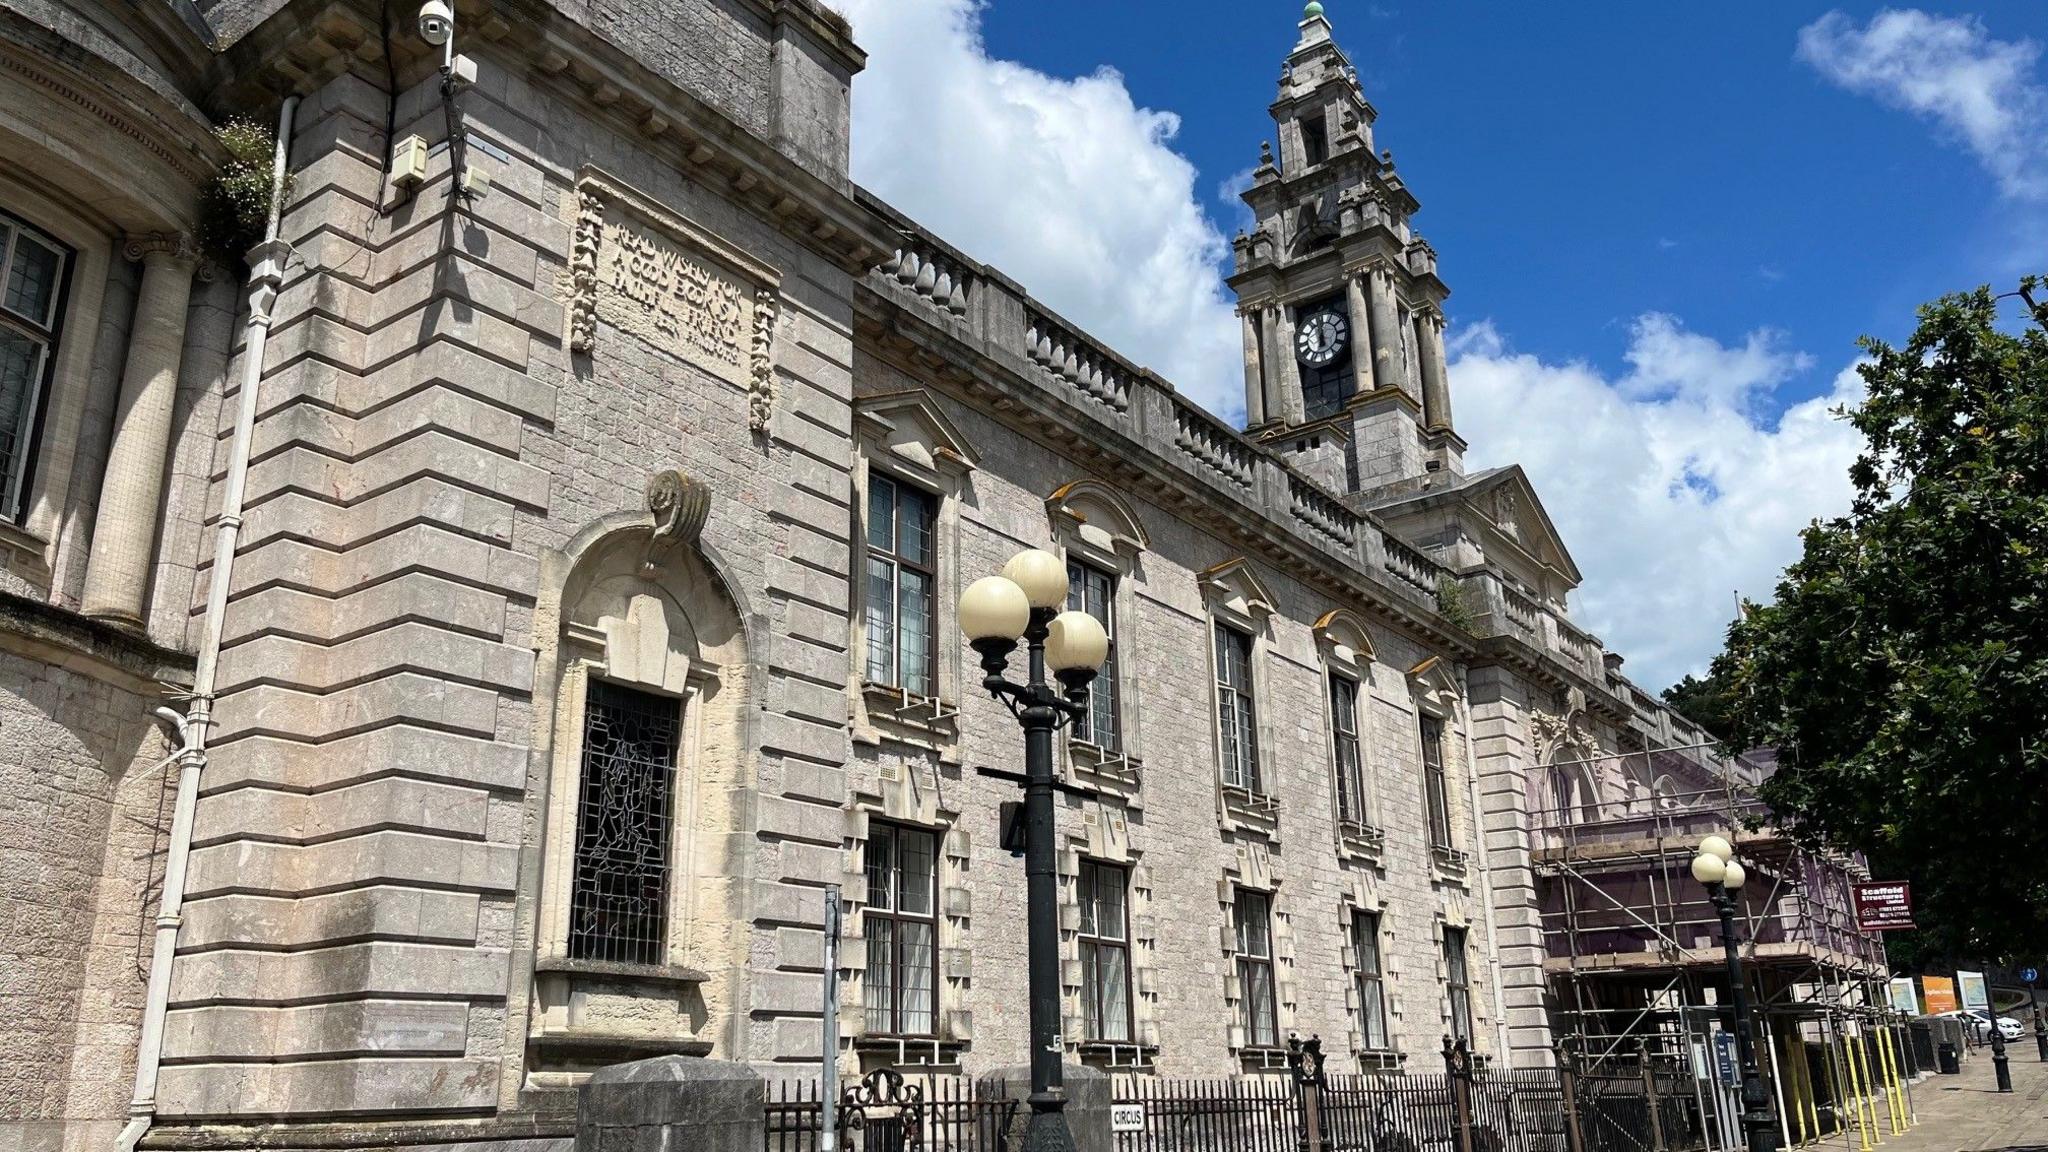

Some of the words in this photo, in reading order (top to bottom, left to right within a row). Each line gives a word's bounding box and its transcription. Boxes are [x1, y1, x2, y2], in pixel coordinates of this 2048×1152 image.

[617, 222, 656, 256] READ
[661, 247, 710, 287] WISELY
[714, 276, 742, 312] FOR
[612, 247, 625, 270] A
[630, 256, 669, 287] GOOD
[674, 278, 714, 315] BOOK
[1861, 886, 1904, 896] Scaffold
[1861, 894, 1905, 902] Structures
[1114, 1110, 1142, 1125] CIRCUS
